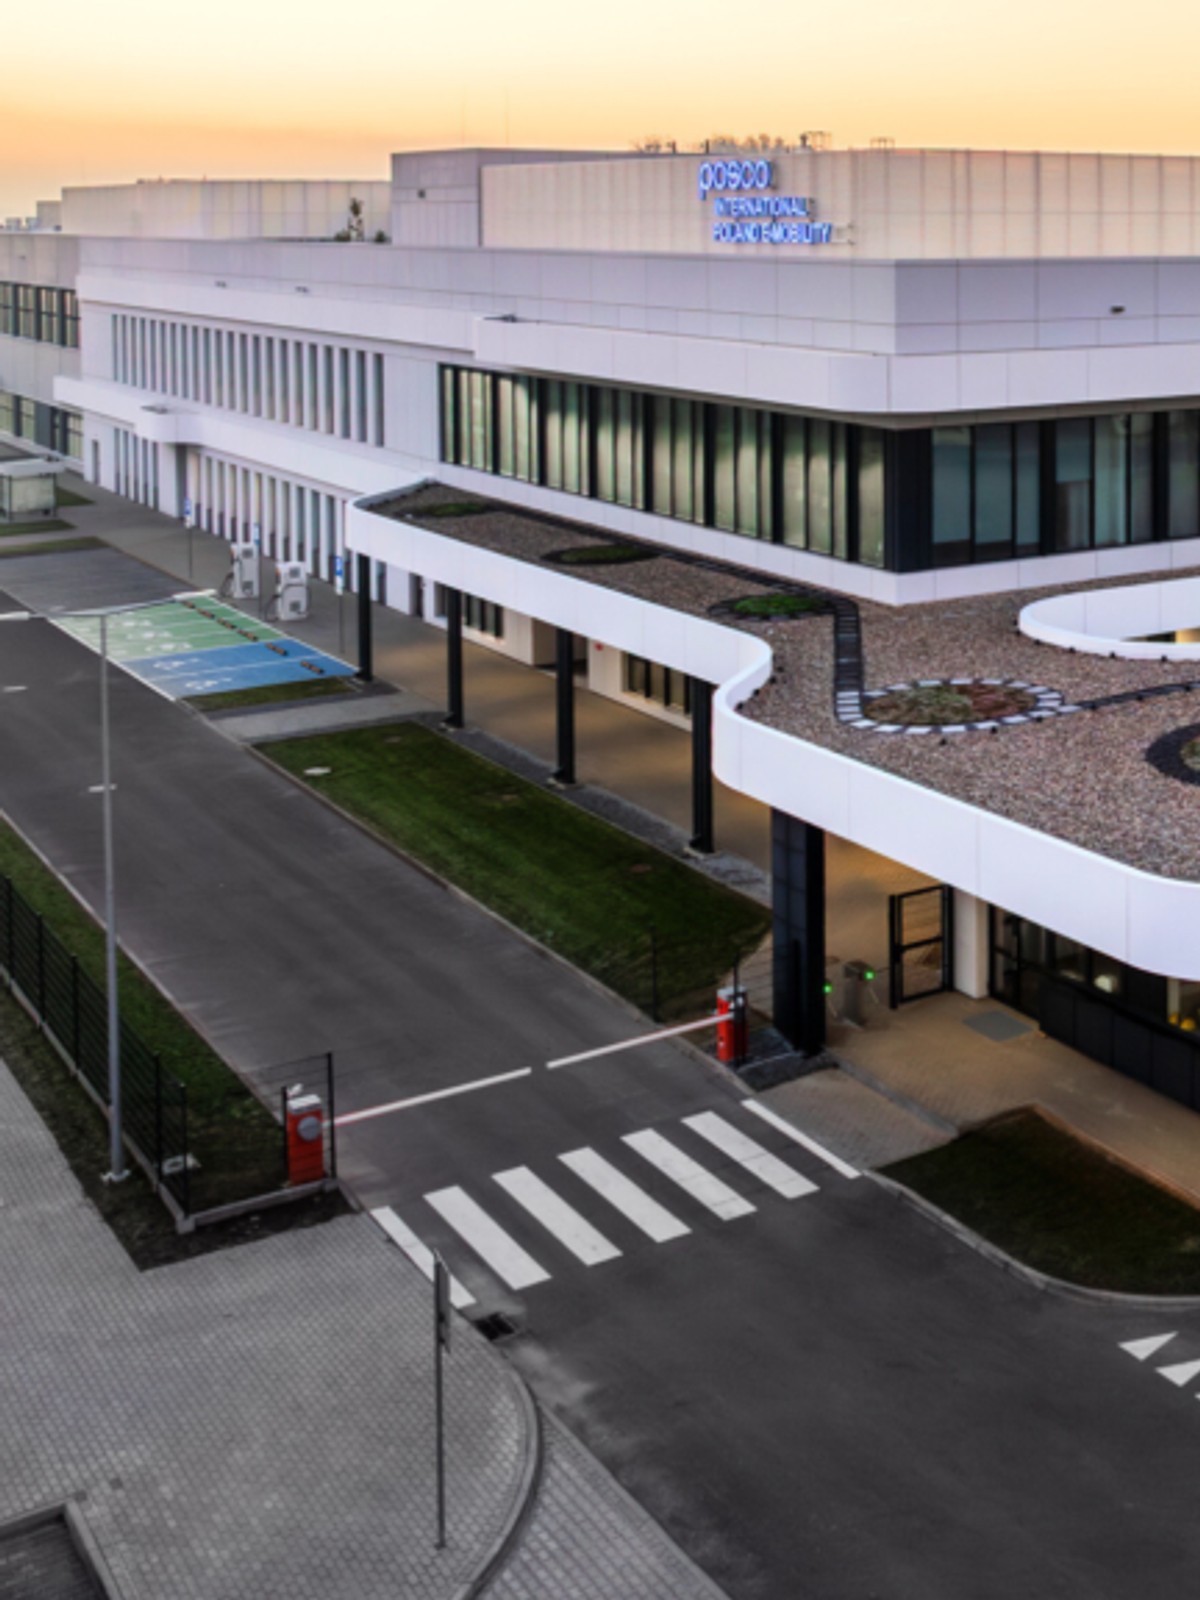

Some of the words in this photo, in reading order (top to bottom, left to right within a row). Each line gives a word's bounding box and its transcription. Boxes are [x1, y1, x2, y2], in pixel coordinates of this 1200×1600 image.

[698, 160, 772, 201] posco
[714, 196, 808, 217] INTERNATIONAL
[713, 222, 761, 243] POLAND
[762, 222, 832, 244] E-MOBILITY
